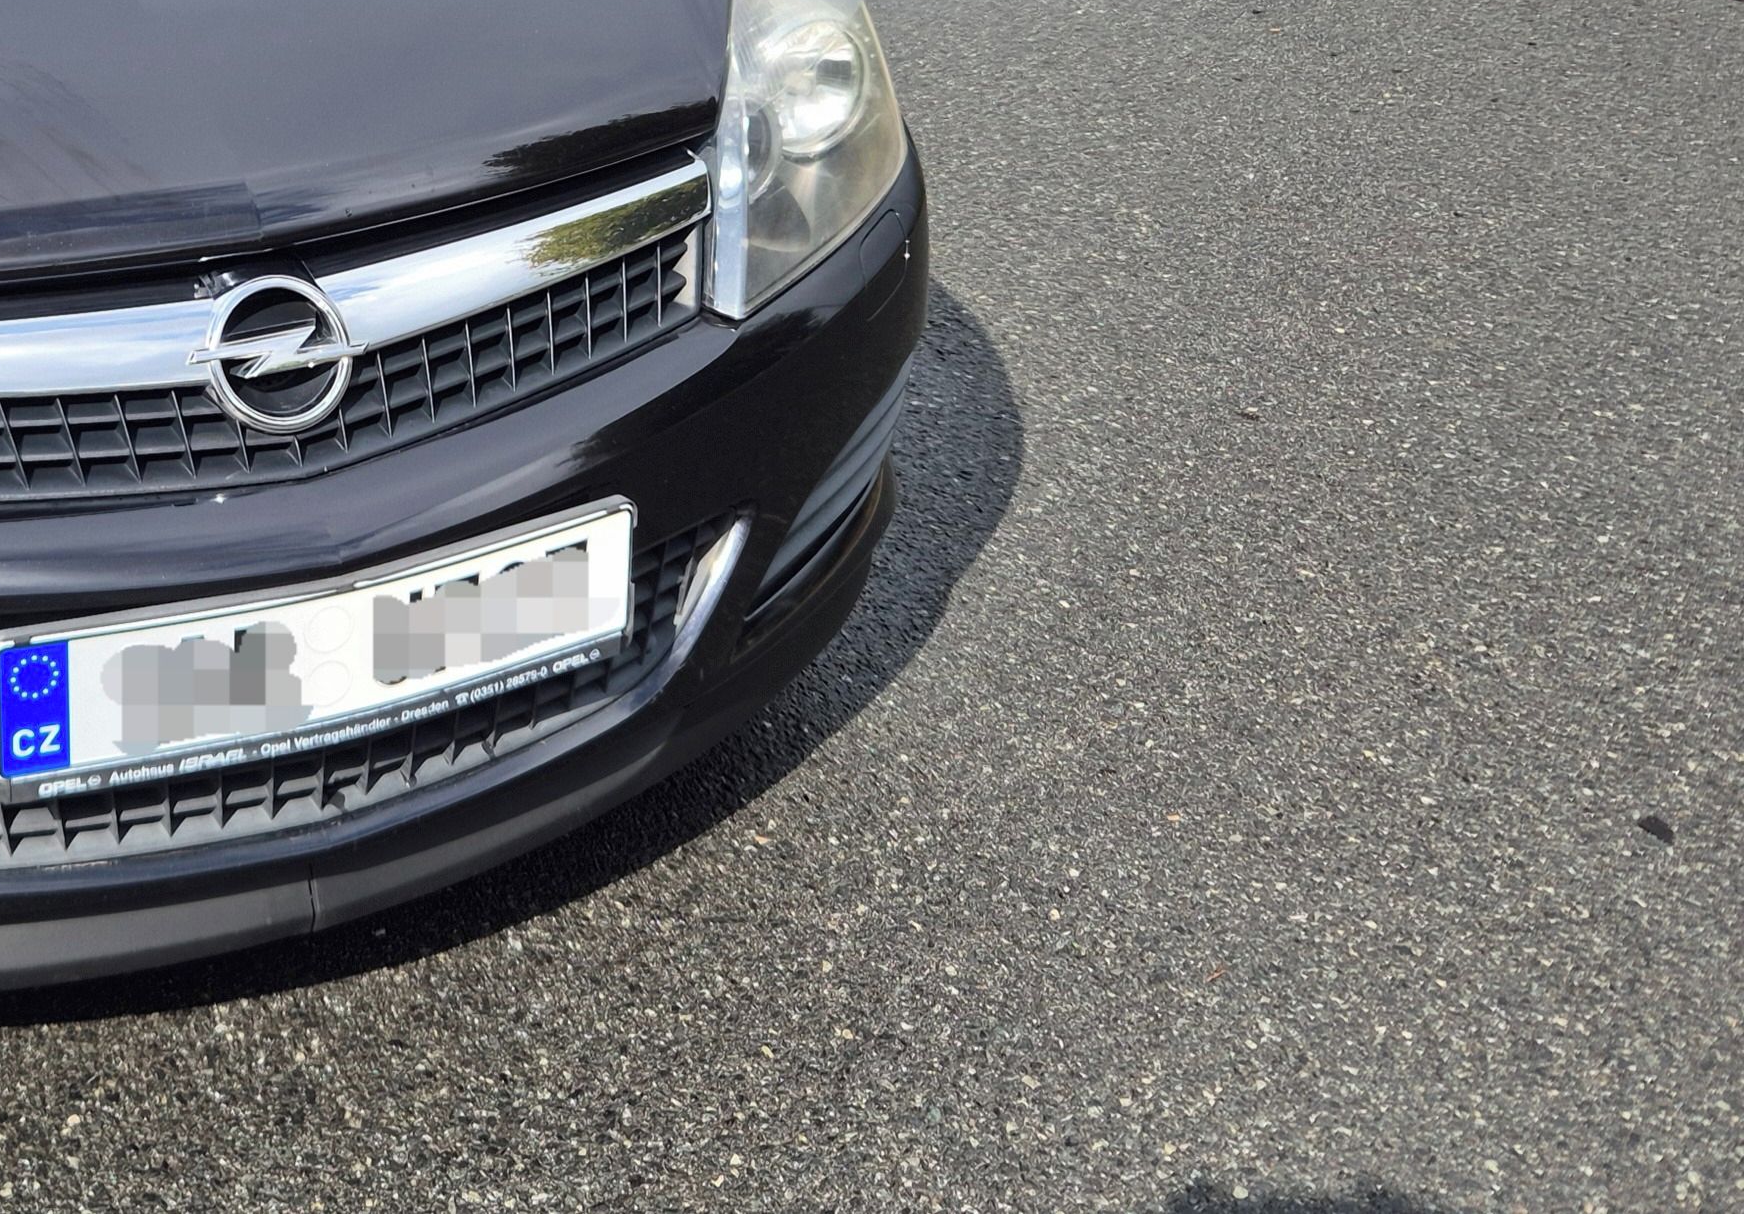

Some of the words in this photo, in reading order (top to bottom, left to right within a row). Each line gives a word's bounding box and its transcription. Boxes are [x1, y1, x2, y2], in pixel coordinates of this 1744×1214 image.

[12, 724, 61, 758] CZ
[38, 776, 87, 798] OPEL
[109, 762, 175, 786] Autohaus
[260, 738, 291, 758] Opel
[293, 716, 392, 751] Vertragshändler
[401, 698, 449, 722] Dresden
[552, 652, 589, 674] OPEL
